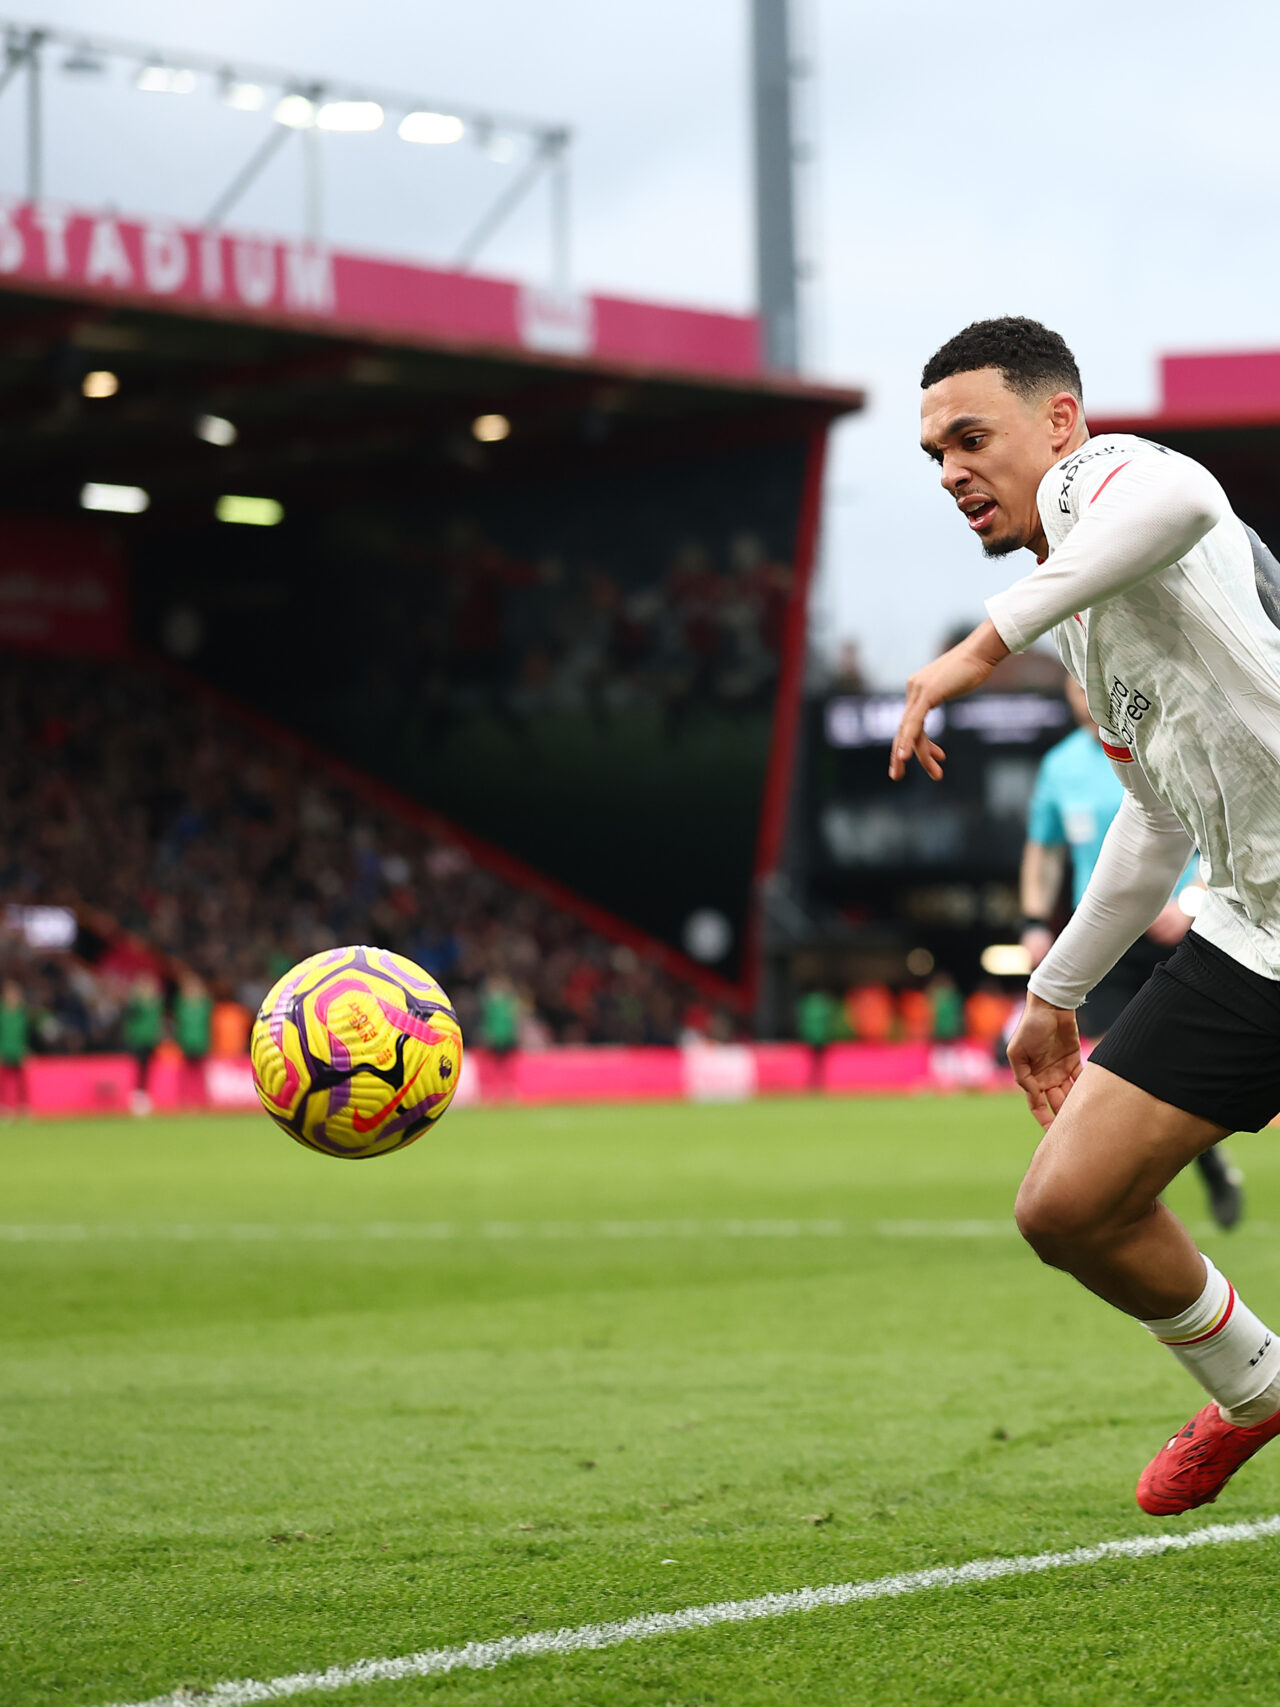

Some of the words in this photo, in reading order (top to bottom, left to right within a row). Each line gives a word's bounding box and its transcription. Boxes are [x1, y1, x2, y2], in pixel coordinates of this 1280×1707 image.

[348, 1002, 379, 1039] FLIGHT
[349, 1015, 373, 1043] NIKE
[1249, 1333, 1271, 1366] LFC
